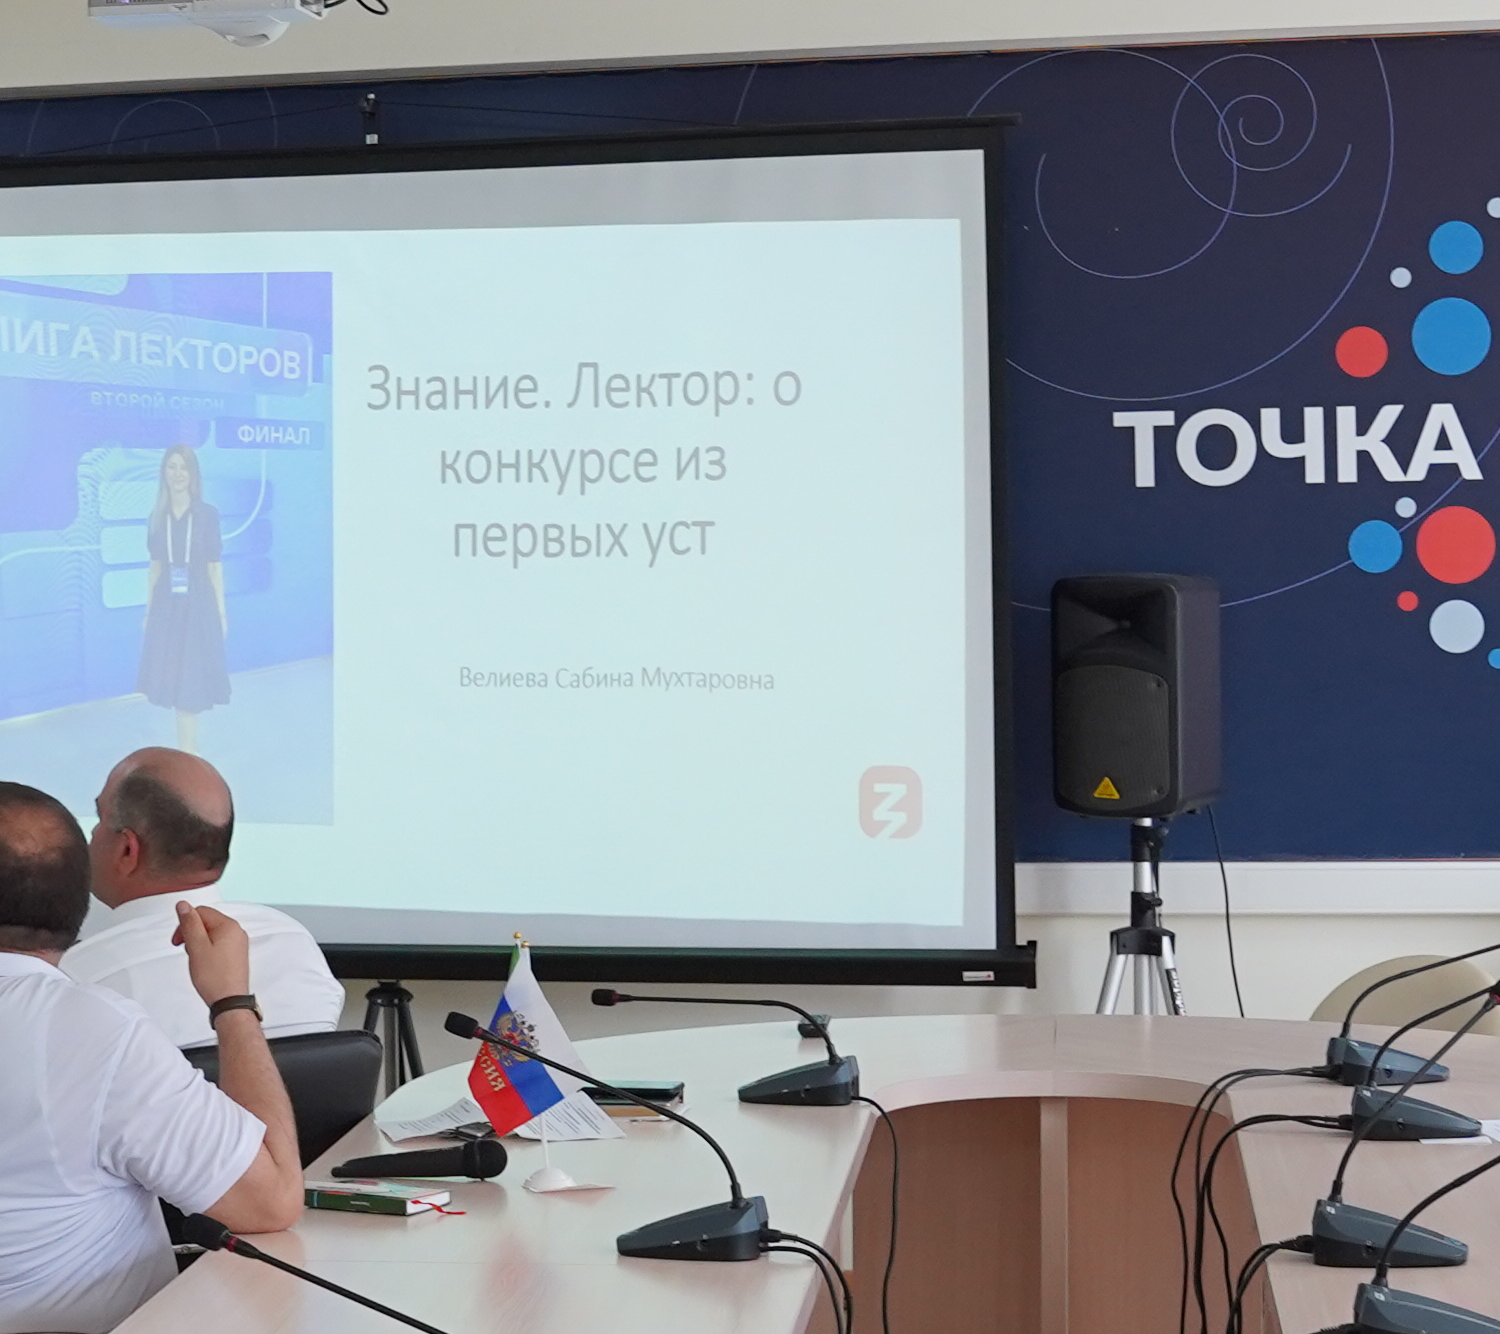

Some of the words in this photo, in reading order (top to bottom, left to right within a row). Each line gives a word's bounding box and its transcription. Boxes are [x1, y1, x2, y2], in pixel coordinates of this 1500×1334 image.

[112, 329, 302, 380] ЛЕКТОРОВ
[90, 390, 166, 409] ВТОРОЙ
[367, 364, 552, 411] Знание.
[566, 362, 755, 417] Лектор:
[772, 370, 802, 407] о
[236, 424, 311, 446] ФИНАЛ
[1113, 405, 1484, 488] ТОЧКА
[440, 447, 659, 495] конкурсе
[674, 445, 728, 482] из
[453, 520, 629, 568] первых
[642, 519, 716, 568] уст
[459, 666, 549, 689] Велиева
[555, 665, 635, 690] Сабина
[641, 666, 775, 693] Мухтаровна
